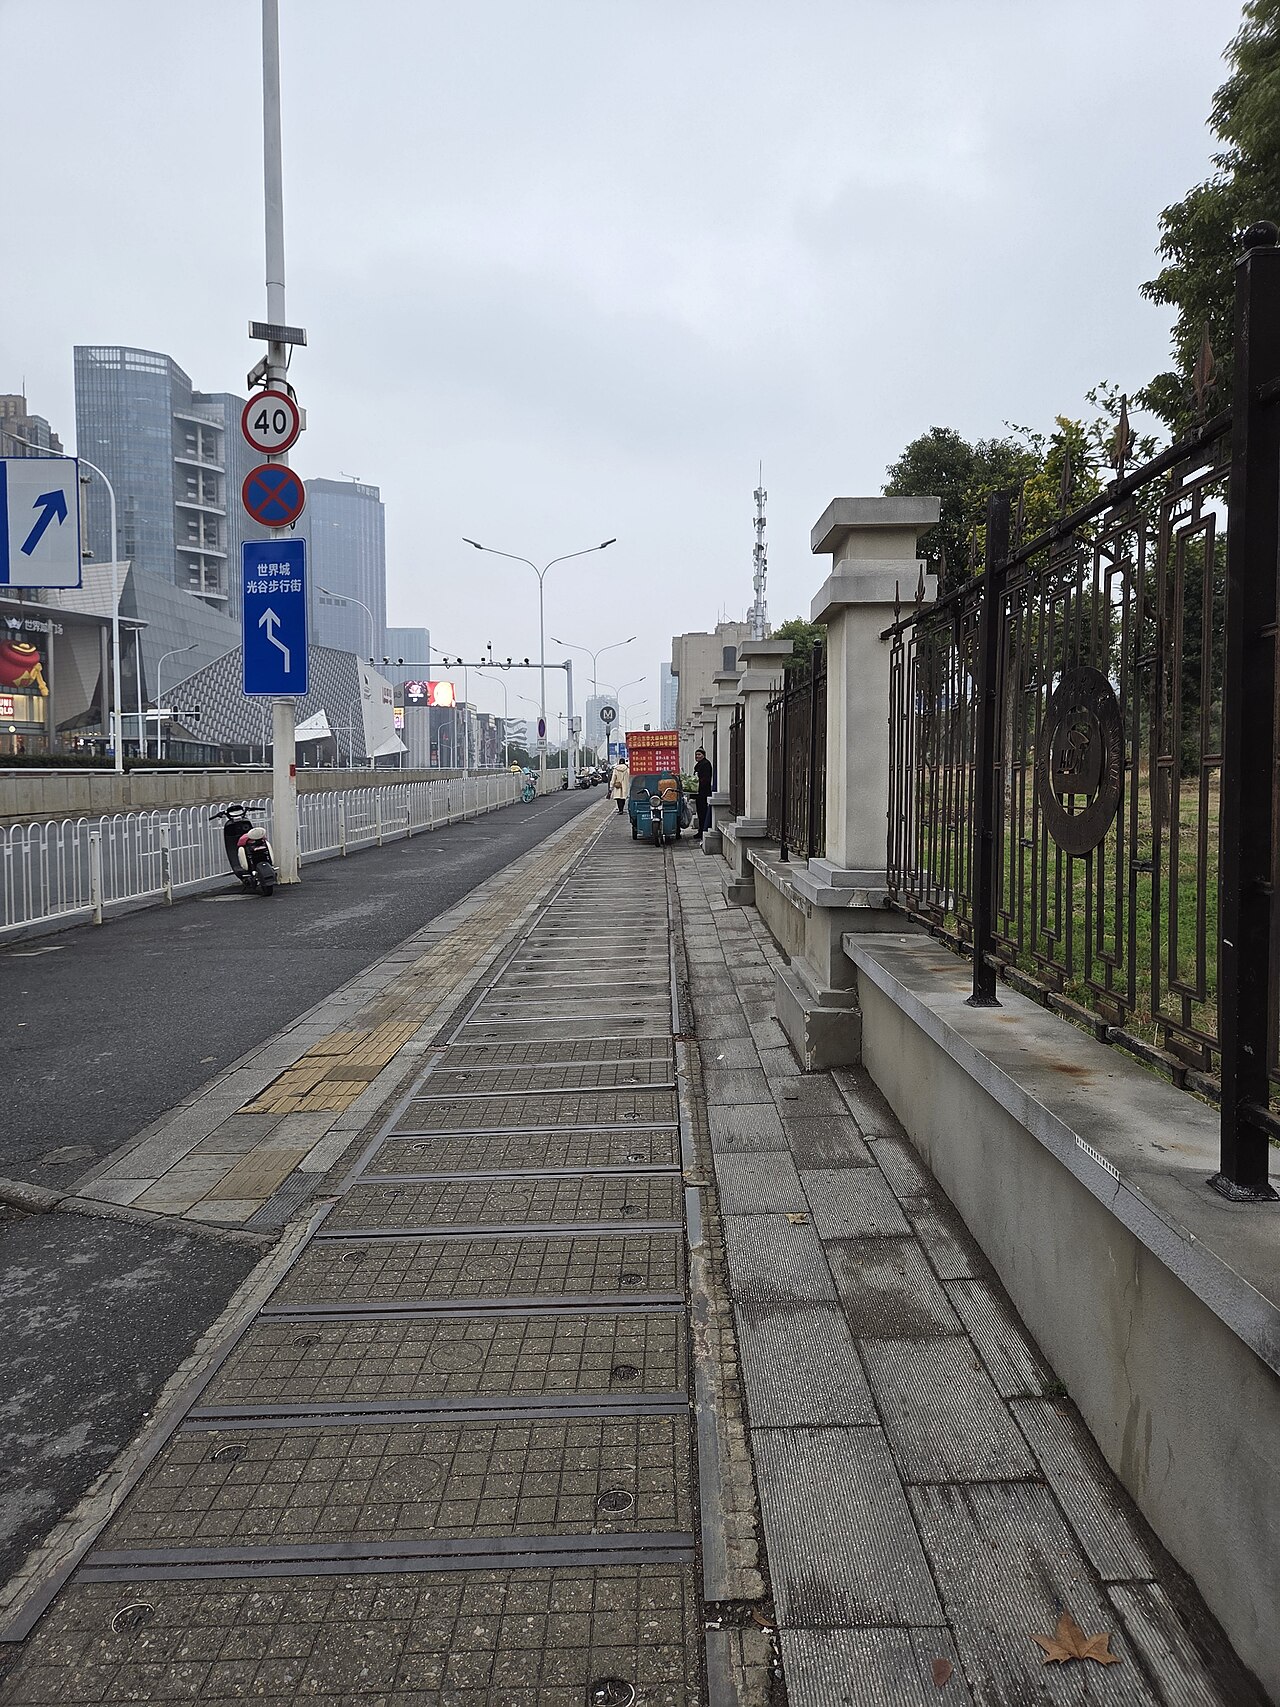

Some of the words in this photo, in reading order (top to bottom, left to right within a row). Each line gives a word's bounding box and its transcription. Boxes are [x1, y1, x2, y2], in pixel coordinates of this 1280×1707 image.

[254, 409, 287, 434] 40
[257, 563, 290, 577] 世界城
[246, 579, 302, 593] 光谷步行街
